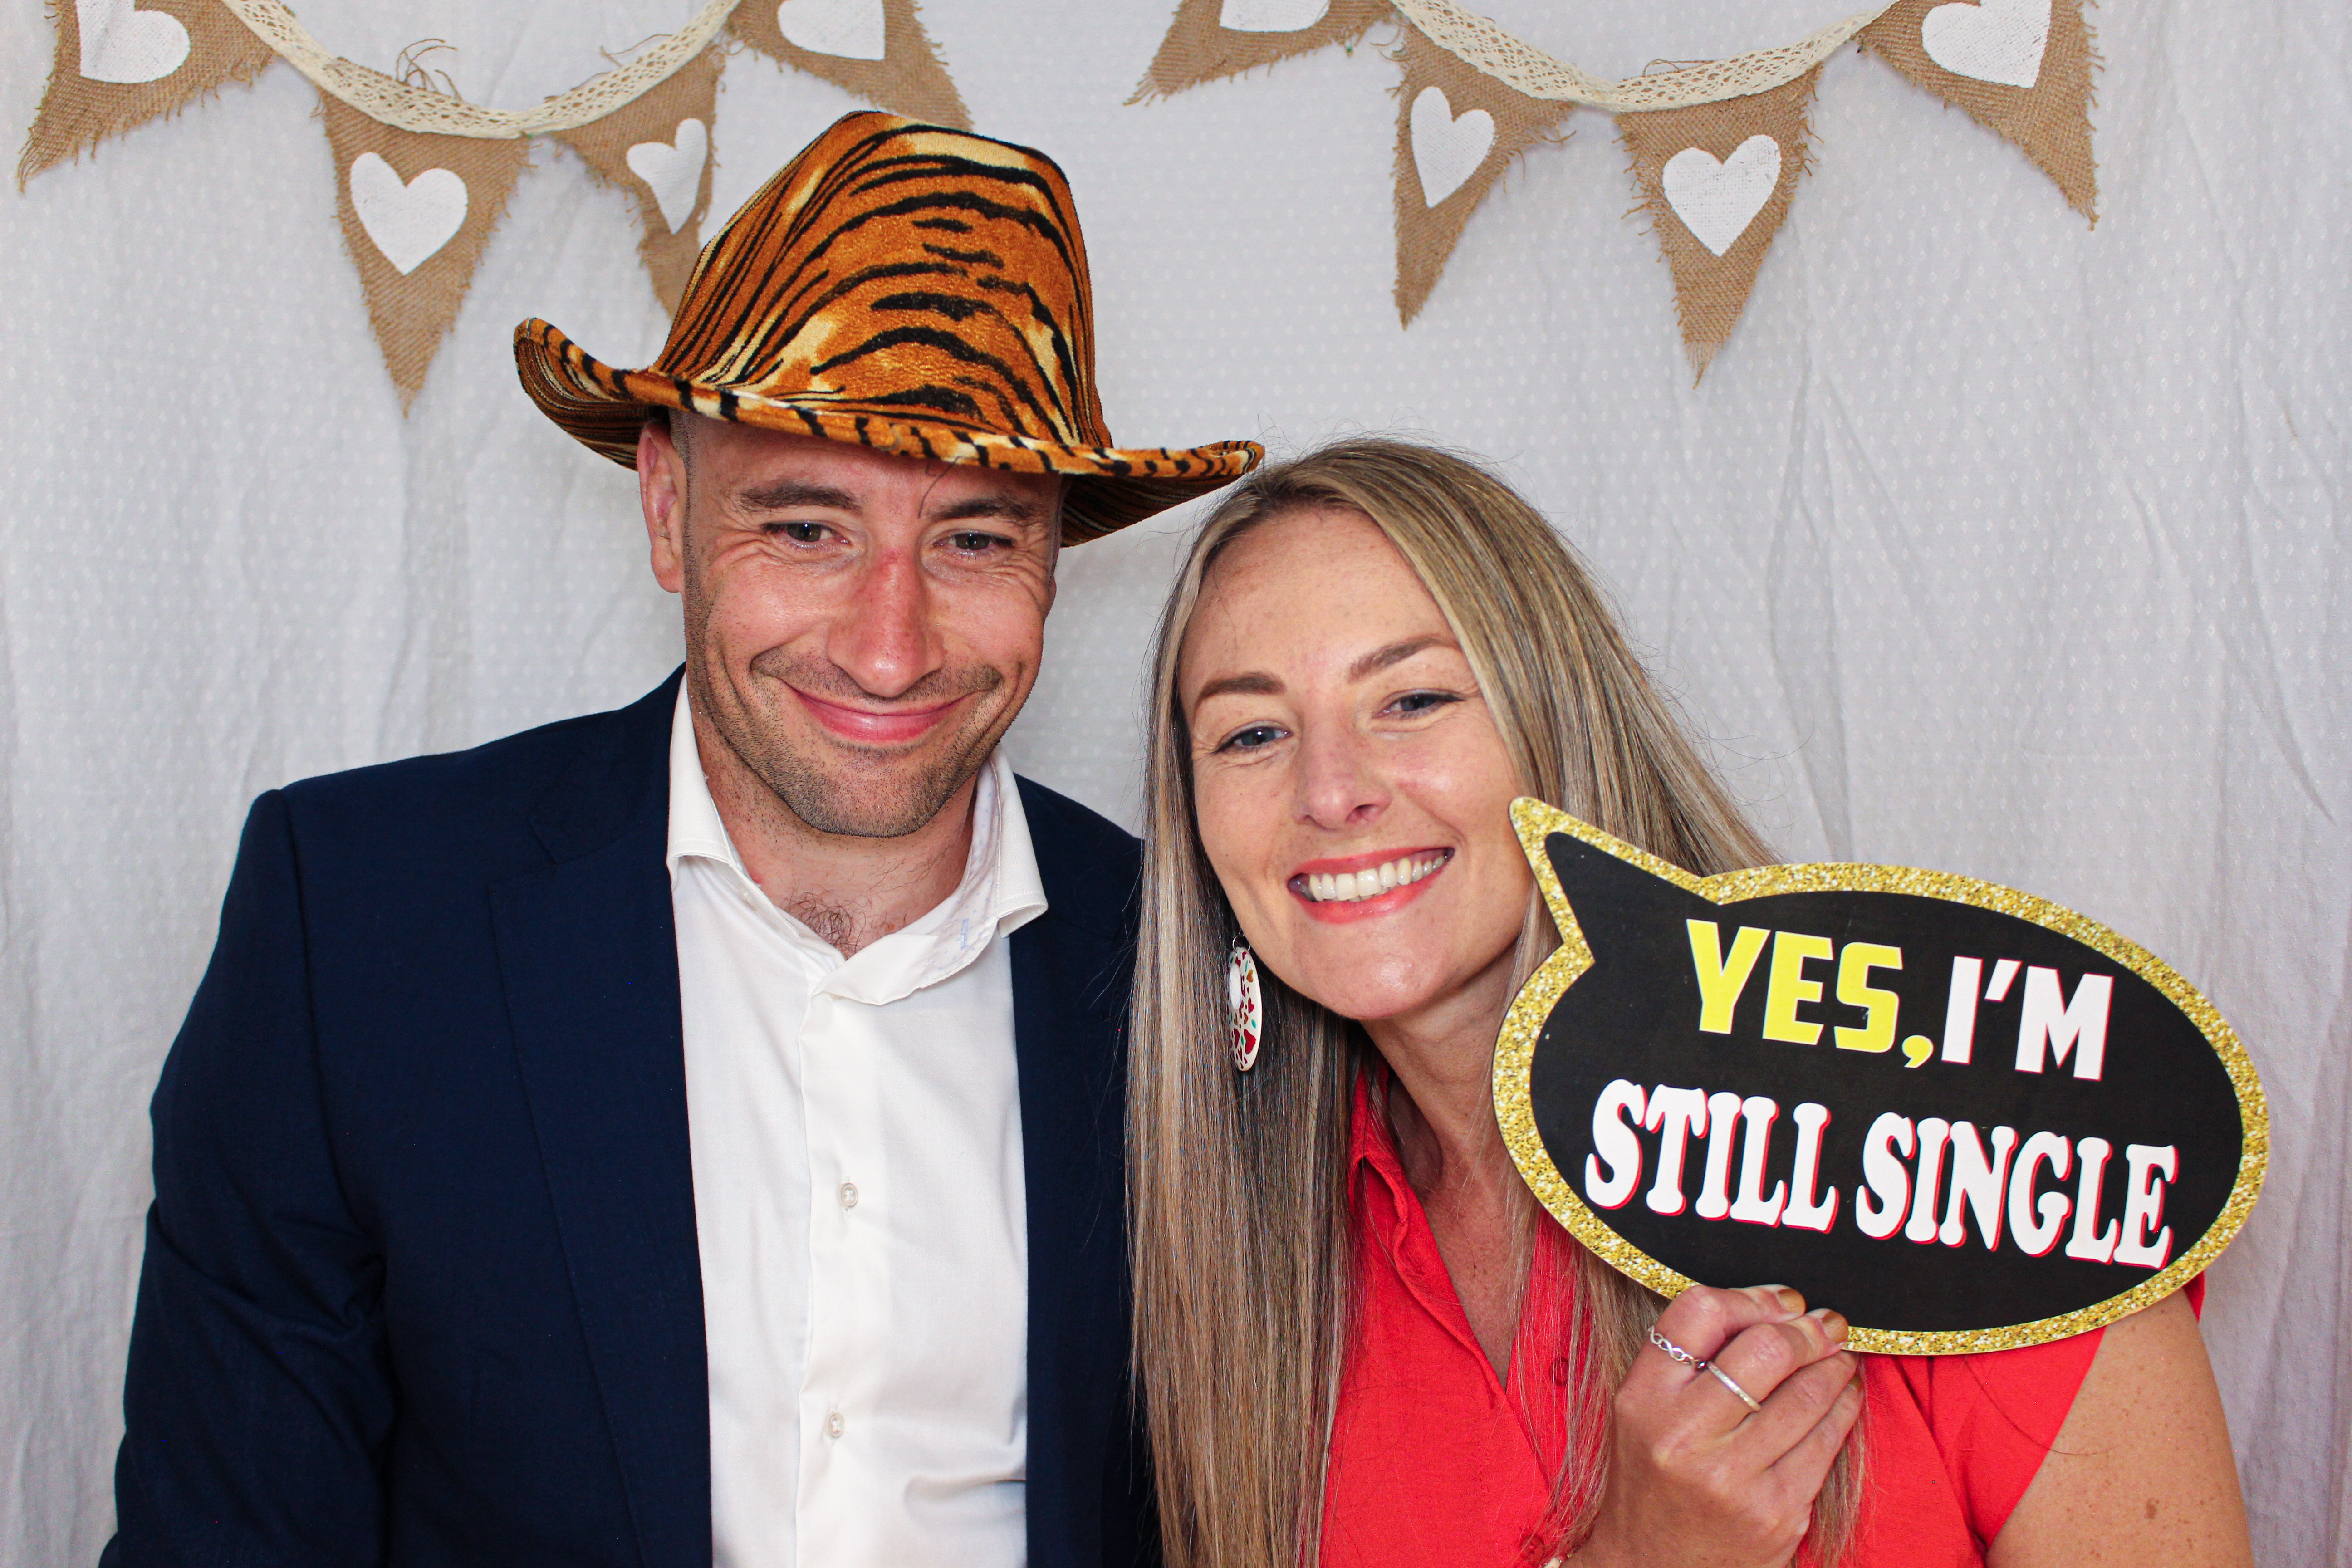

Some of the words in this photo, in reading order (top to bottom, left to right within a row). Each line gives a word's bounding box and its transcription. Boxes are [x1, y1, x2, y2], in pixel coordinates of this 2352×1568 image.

[1686, 919, 1934, 1068] YES,
[1941, 956, 2114, 1082] I'M
[1584, 1079, 1840, 1234] STILL
[1855, 1112, 2179, 1269] SINGLE
